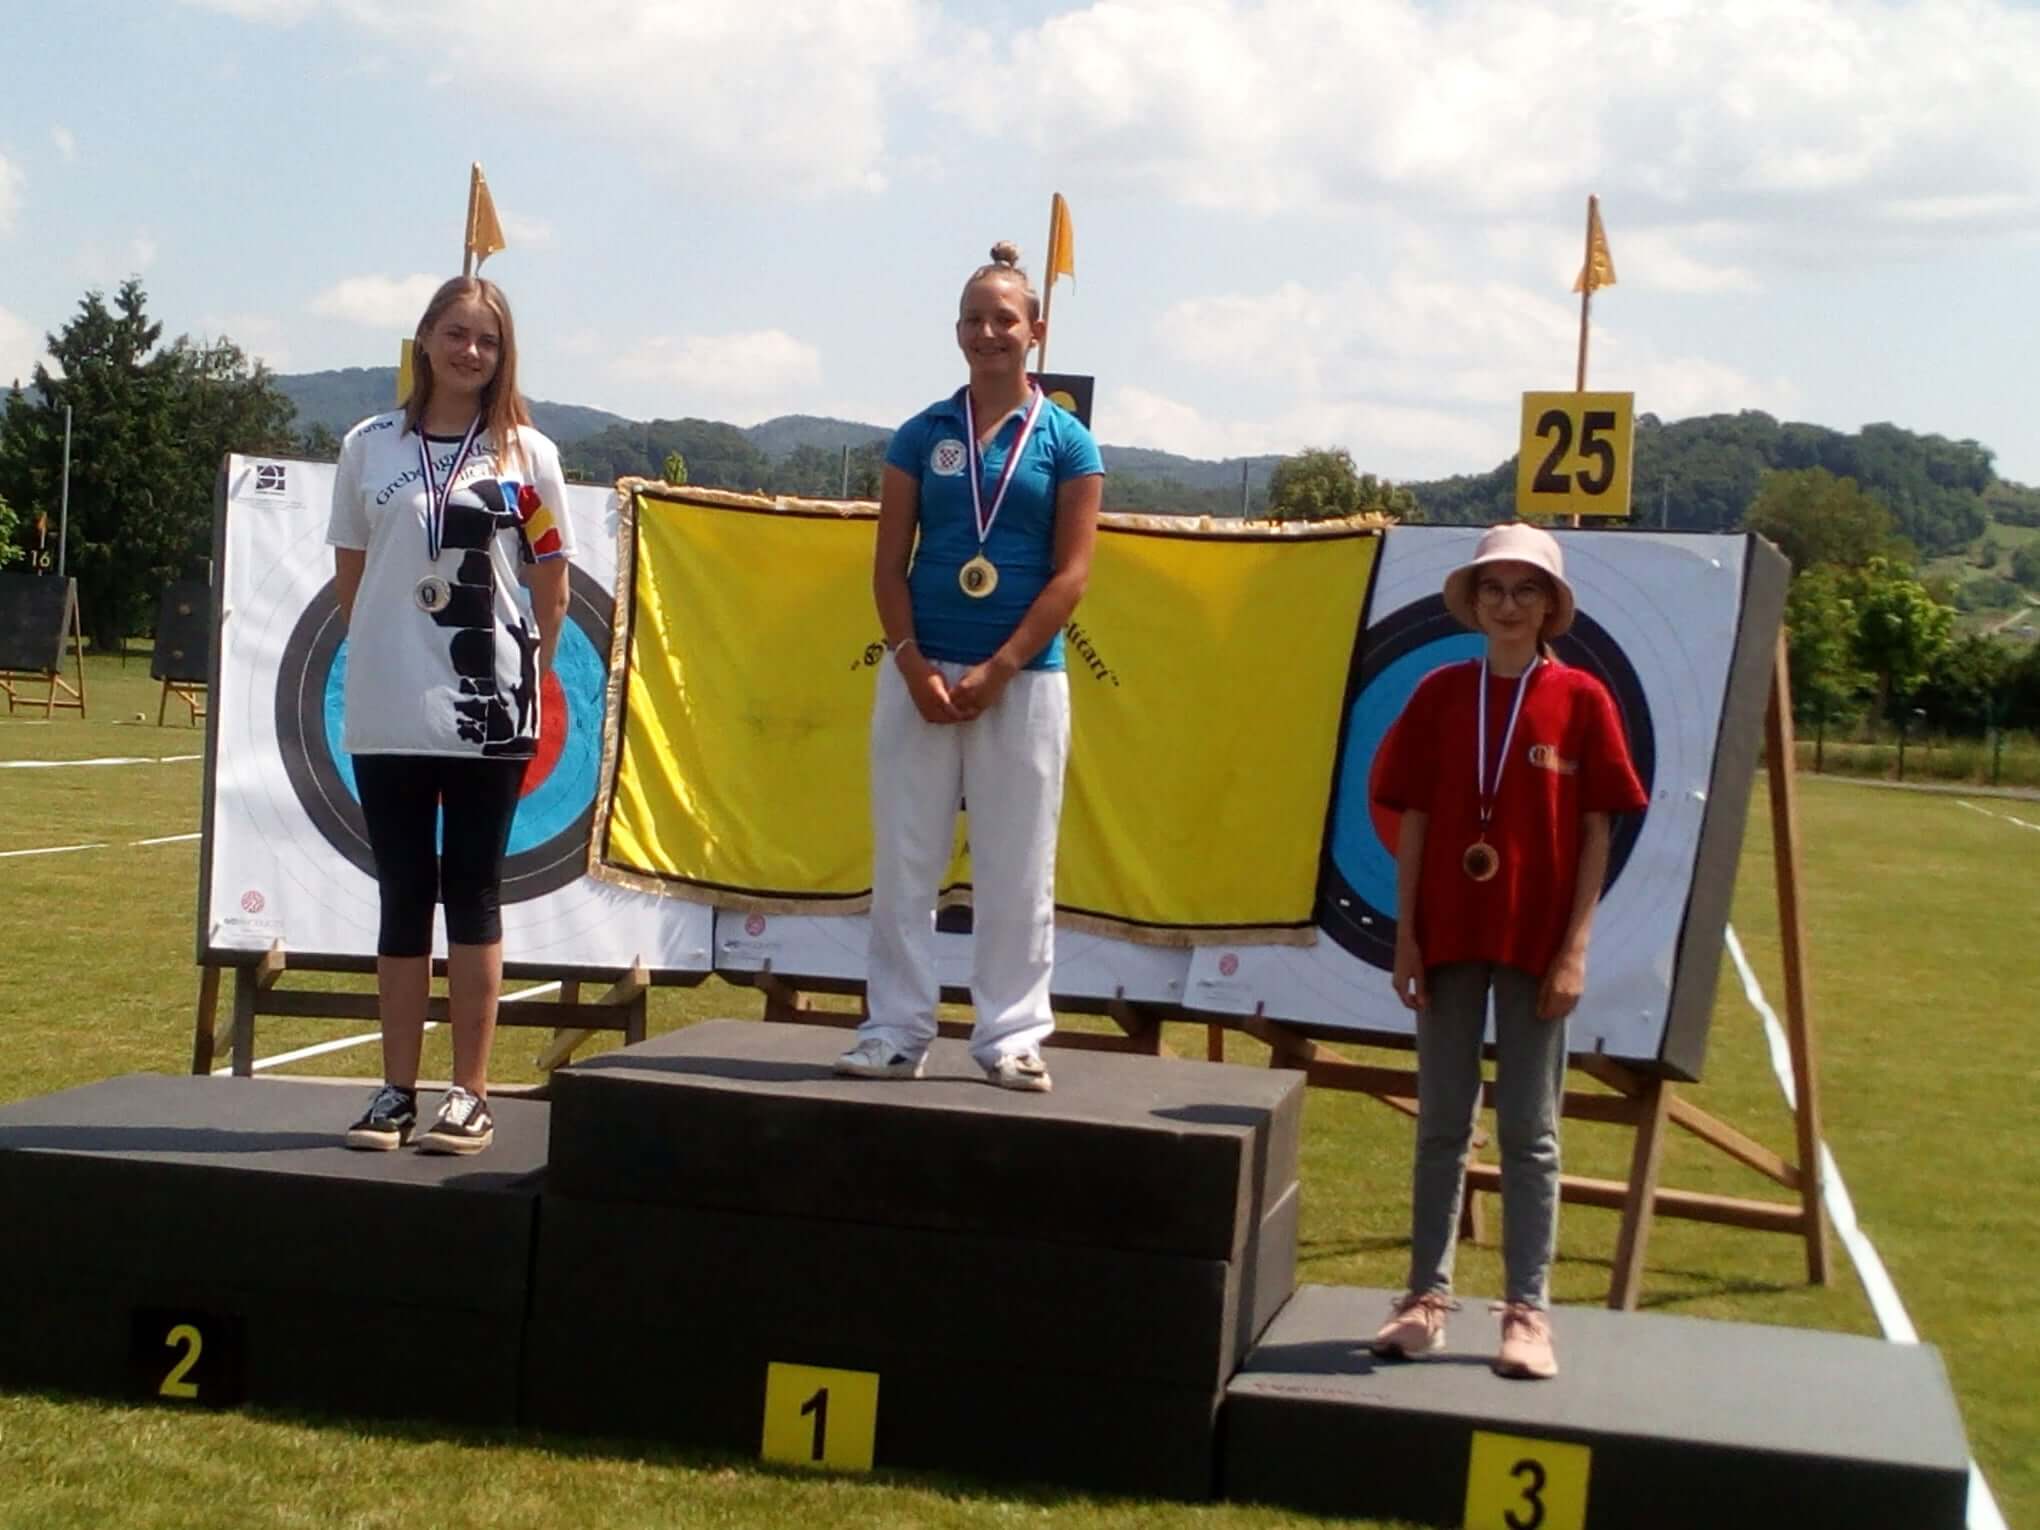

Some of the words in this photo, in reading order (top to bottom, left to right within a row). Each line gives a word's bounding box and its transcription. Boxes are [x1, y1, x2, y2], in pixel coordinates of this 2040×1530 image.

[1532, 408, 1616, 496] 25
[31, 550, 50, 567] 16
[160, 1324, 202, 1398] 2
[801, 1387, 828, 1461] 1
[1504, 1458, 1546, 1530] 3
